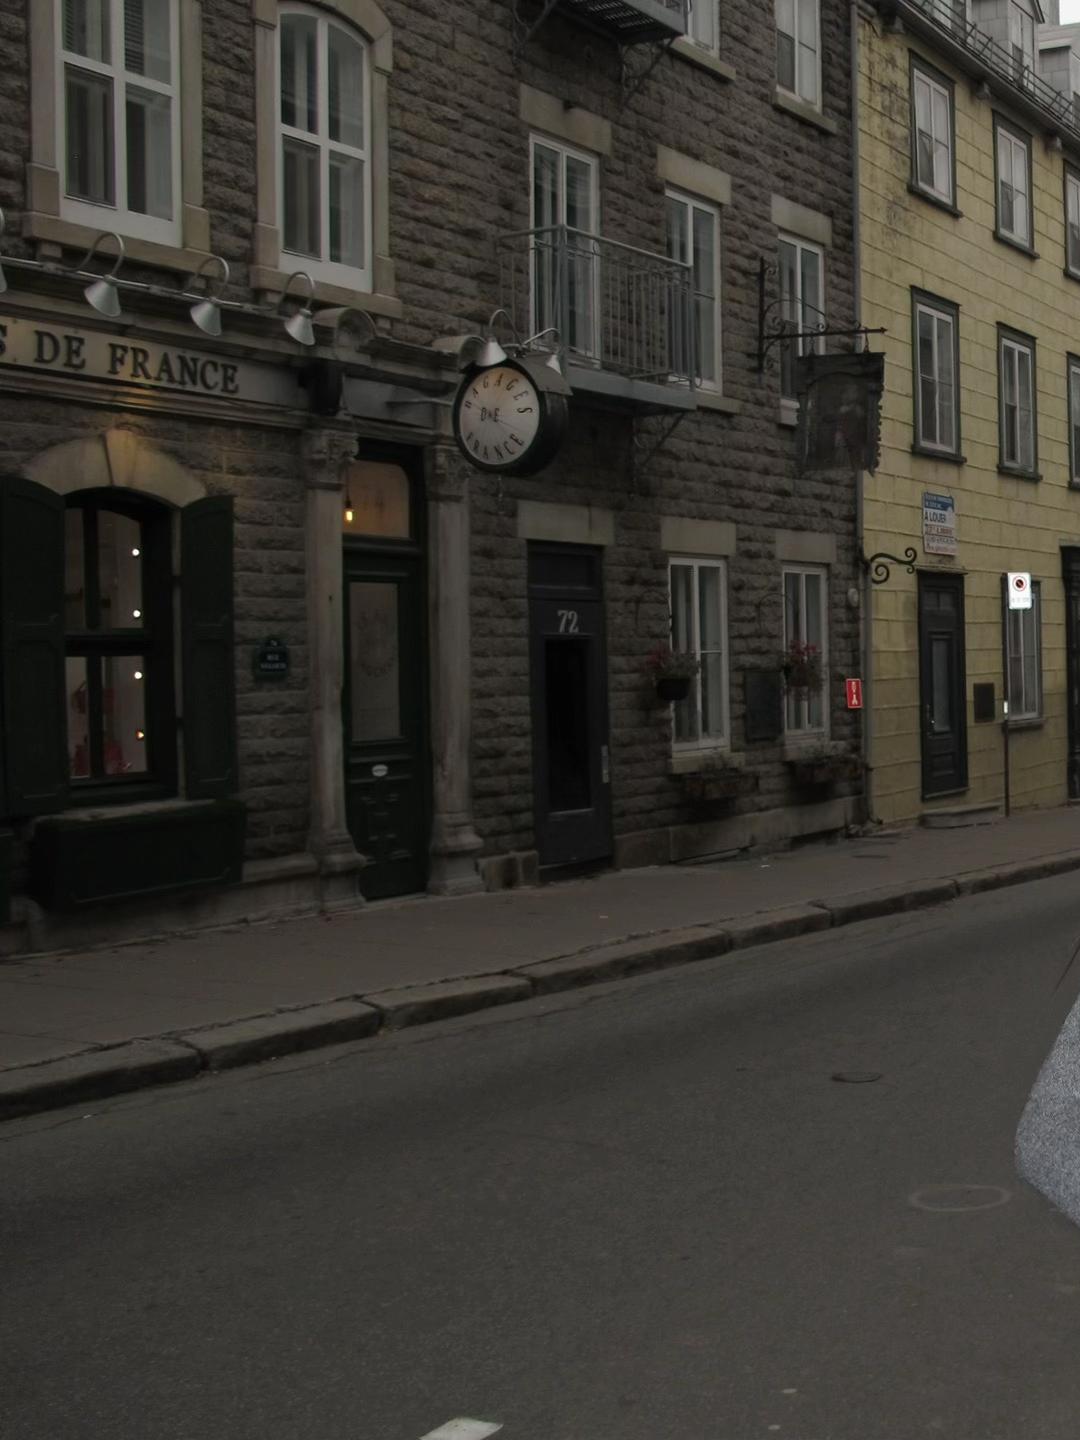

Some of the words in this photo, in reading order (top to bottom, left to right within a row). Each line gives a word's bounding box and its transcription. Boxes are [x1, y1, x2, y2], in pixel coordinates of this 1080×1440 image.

[34, 330, 85, 369] DE
[108, 343, 239, 394] FRANCE
[464, 373, 533, 414] BAGAGES
[466, 431, 524, 460] FRANCE
[557, 609, 579, 633] 72
